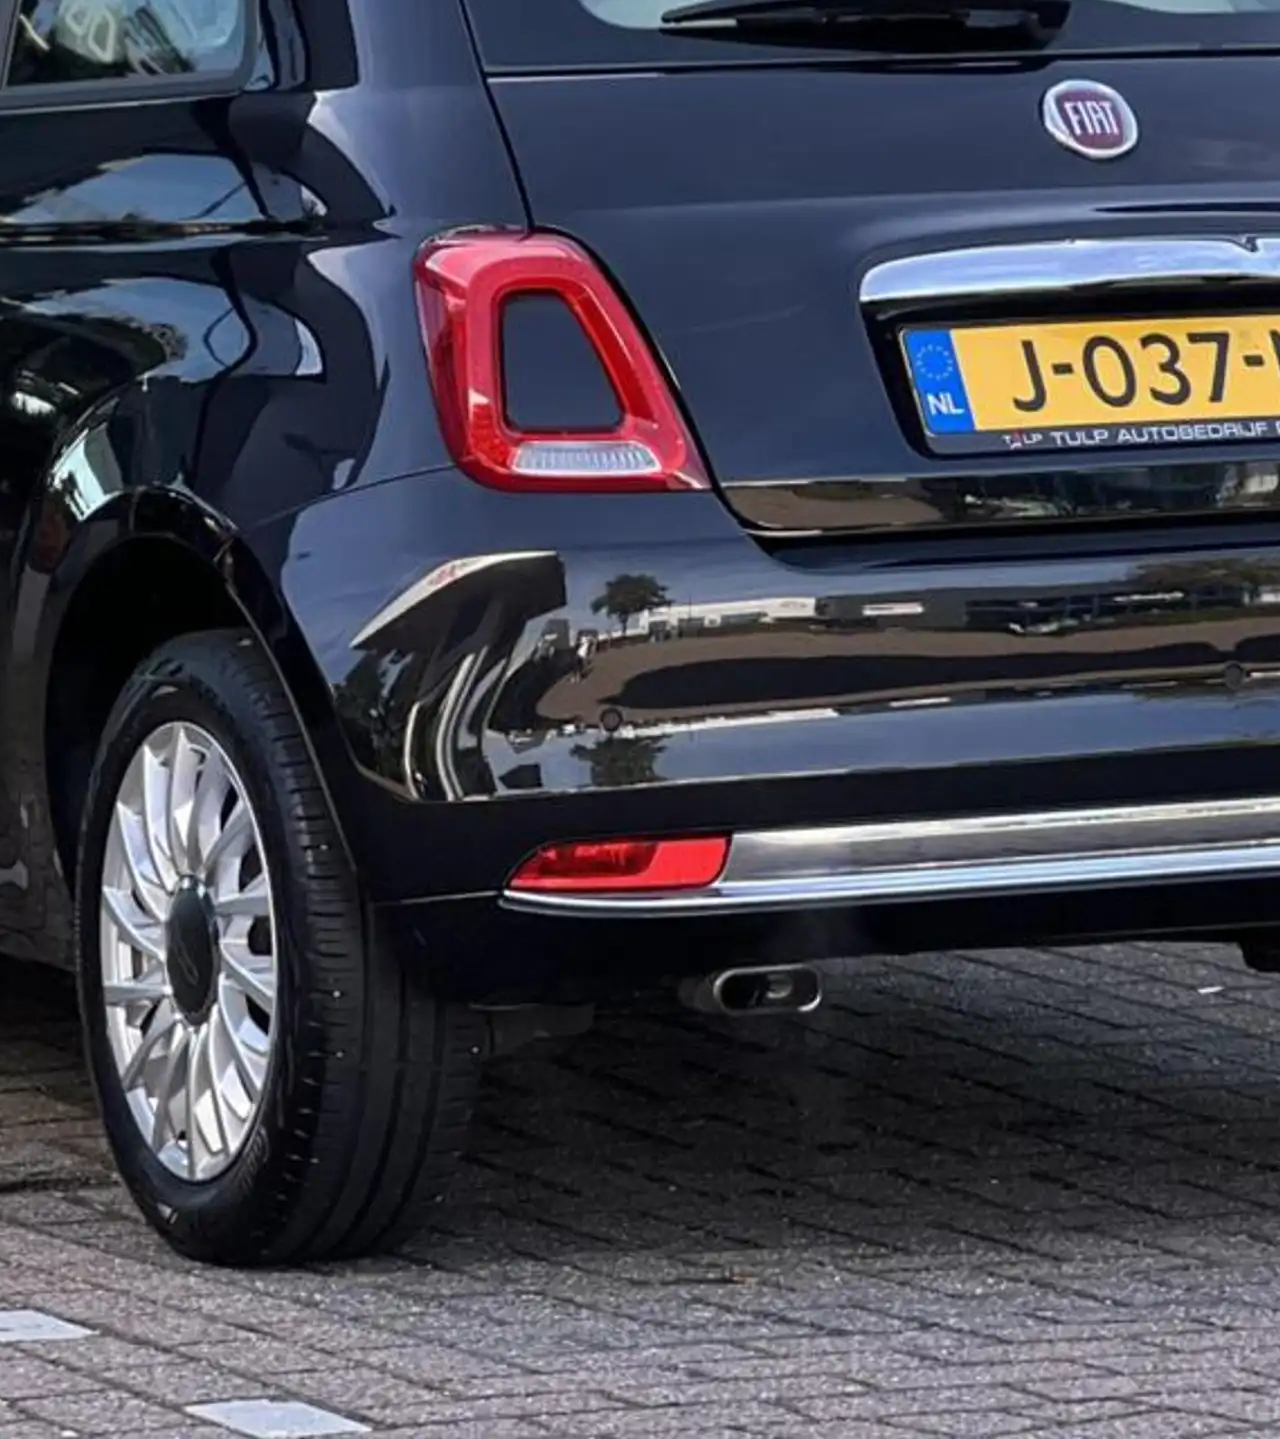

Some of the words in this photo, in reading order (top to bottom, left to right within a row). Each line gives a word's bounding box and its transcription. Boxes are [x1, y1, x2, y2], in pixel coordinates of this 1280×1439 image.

[1064, 100, 1119, 136] FIAT
[927, 392, 965, 415] NL
[1049, 429, 1109, 446] TULP
[1117, 422, 1270, 443] AUTOBEDRIJF
